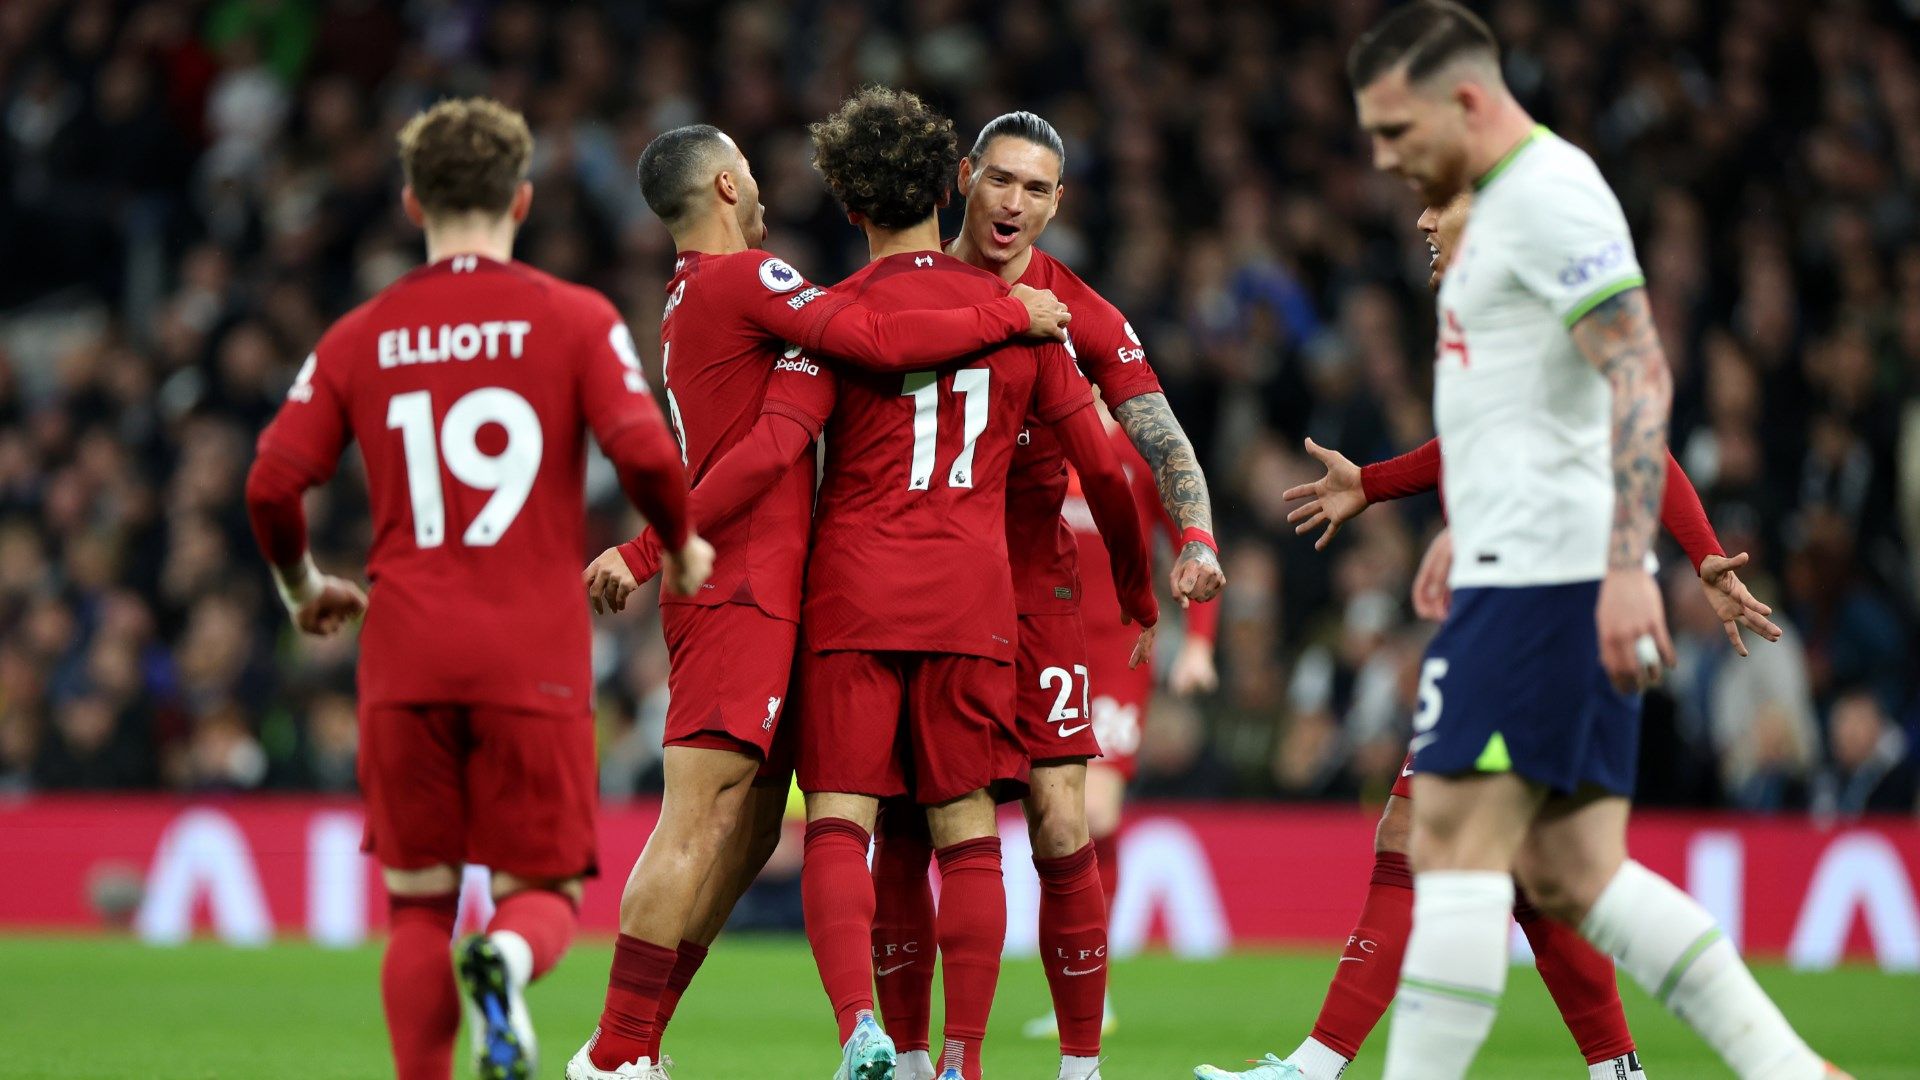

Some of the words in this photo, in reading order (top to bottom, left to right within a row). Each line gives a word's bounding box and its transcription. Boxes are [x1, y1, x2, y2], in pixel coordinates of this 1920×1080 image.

[378, 320, 531, 369] ELLIOTT
[901, 368, 990, 491] 11
[387, 386, 543, 549] 19
[1412, 658, 1448, 733] 5
[1347, 935, 1378, 954] FC
